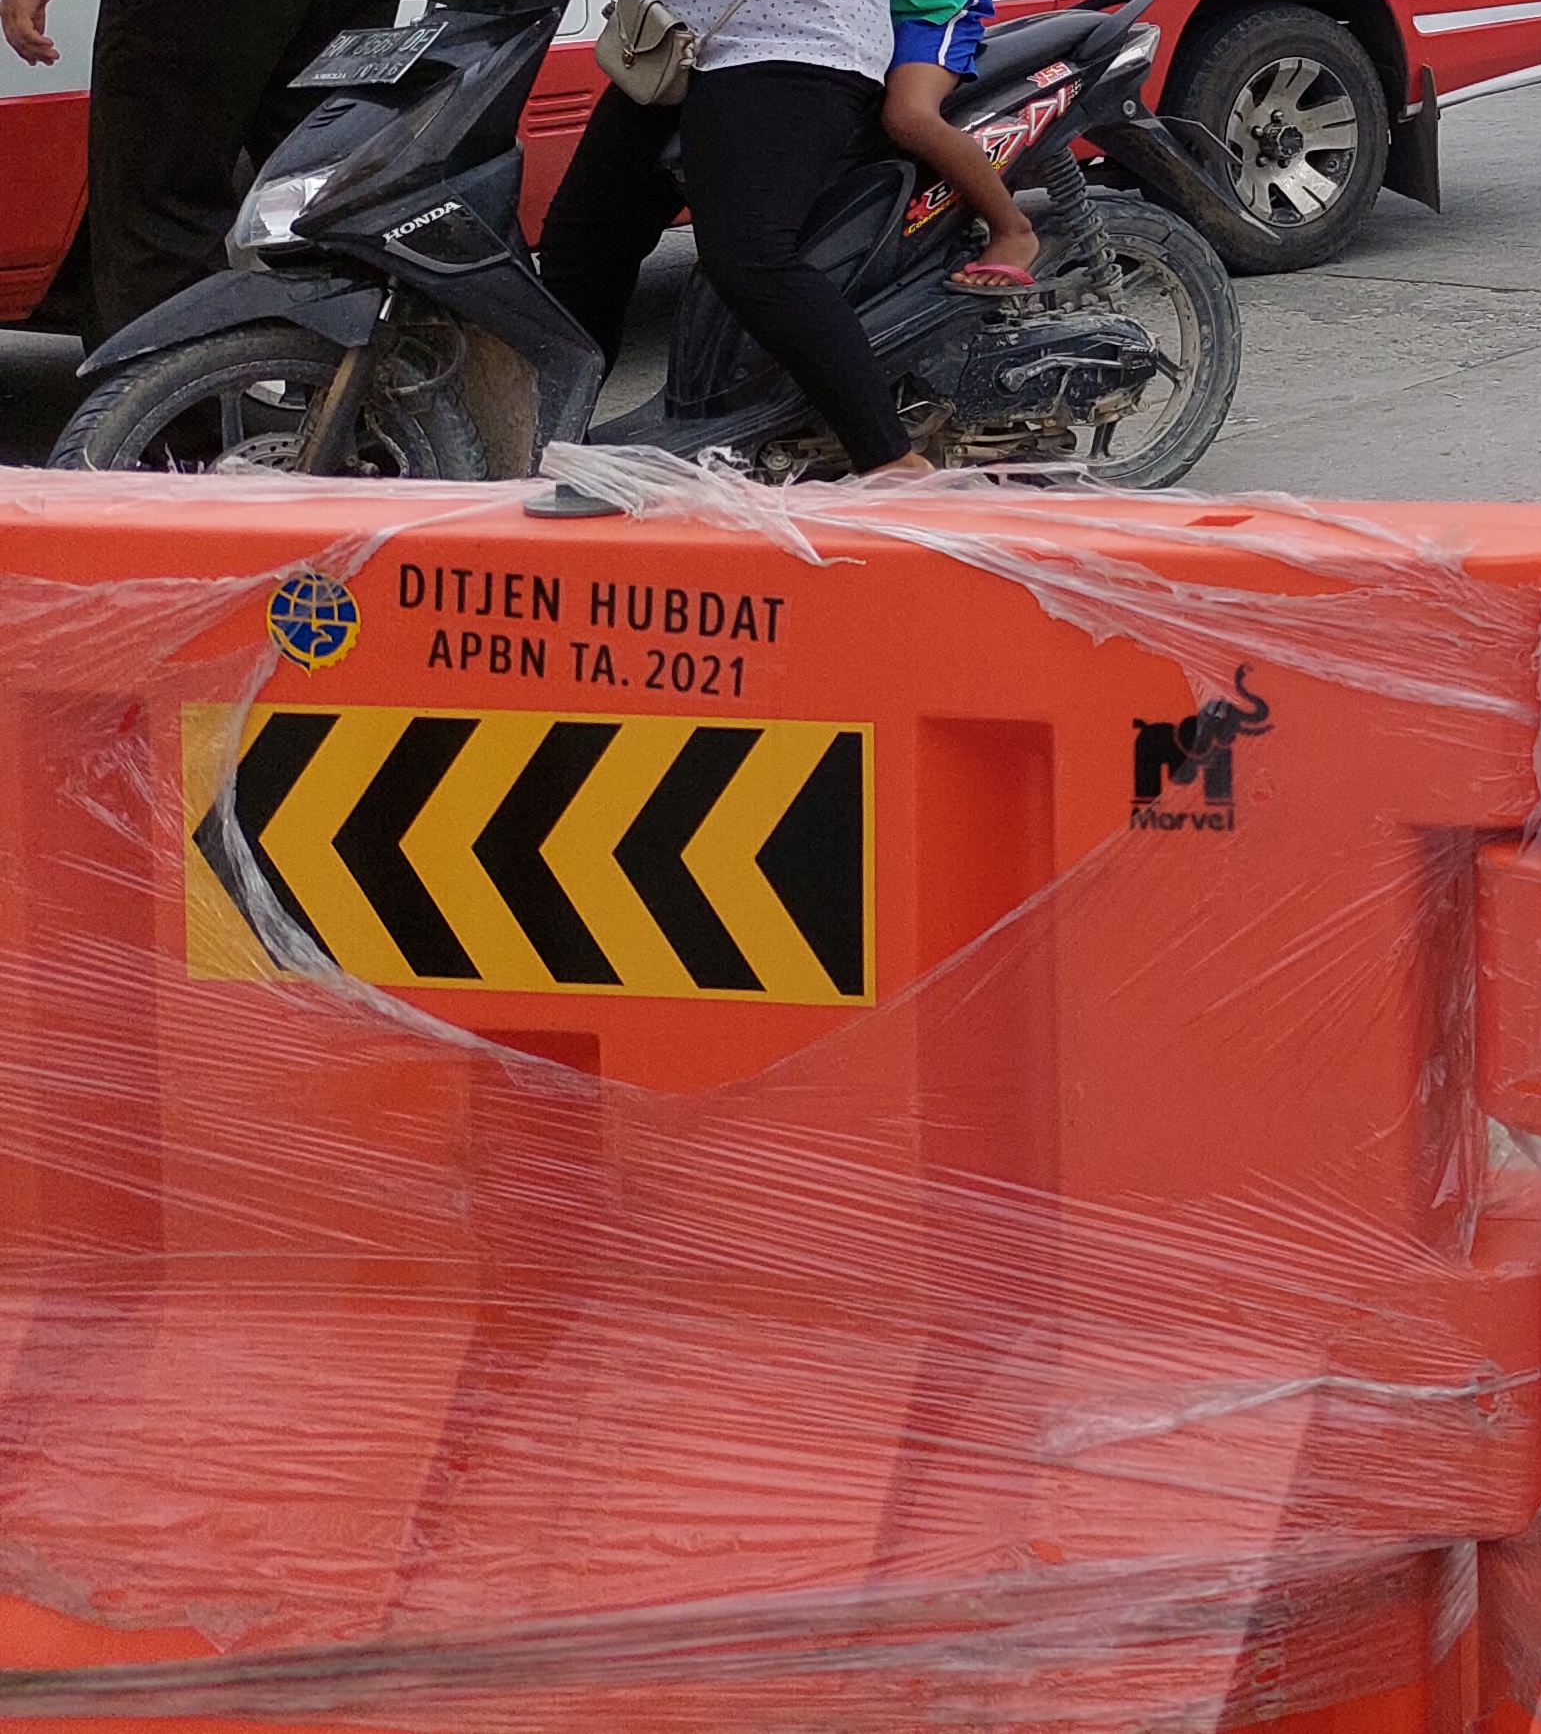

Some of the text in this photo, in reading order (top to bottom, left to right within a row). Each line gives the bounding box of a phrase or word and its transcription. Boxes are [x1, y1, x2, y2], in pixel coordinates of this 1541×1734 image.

[382, 201, 464, 245] HONDA
[399, 563, 785, 644] DITJEN HUBDAT
[427, 628, 744, 699] APBN TA. 2021
[1129, 806, 1235, 833] Marvel
